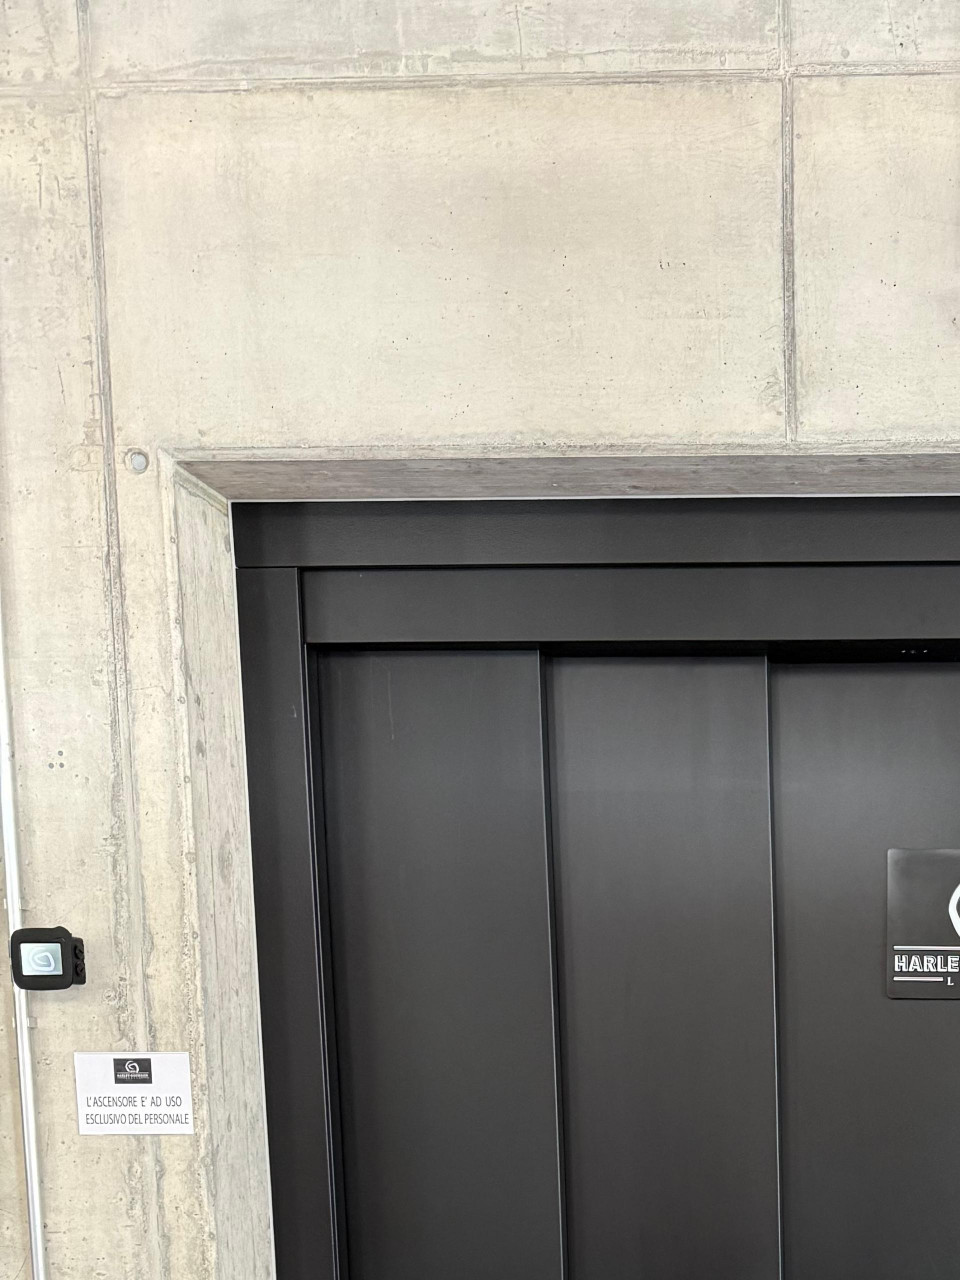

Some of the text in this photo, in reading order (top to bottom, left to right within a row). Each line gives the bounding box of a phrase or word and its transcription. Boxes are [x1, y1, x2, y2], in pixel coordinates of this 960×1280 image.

[86, 1096, 182, 1108] L'ASCENSORE E' AD USO
[85, 1113, 190, 1125] ESCLUSIVO DEL PERSONALE
